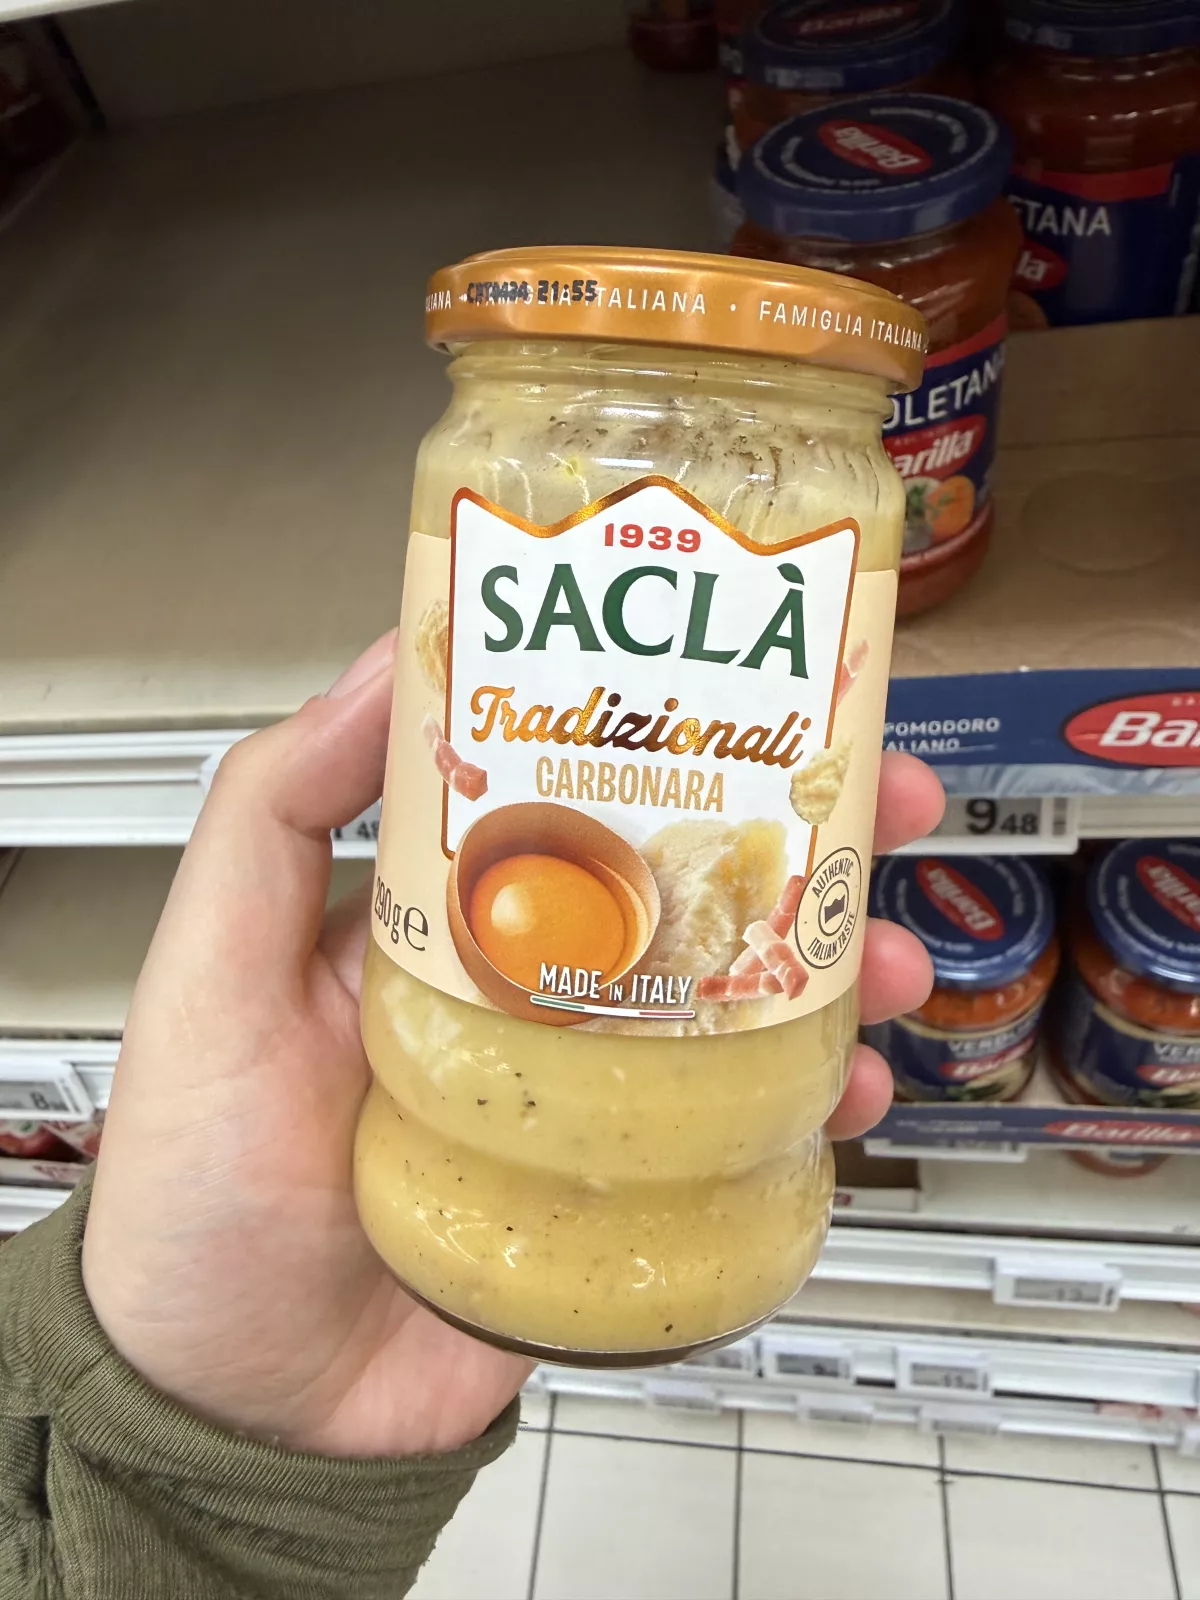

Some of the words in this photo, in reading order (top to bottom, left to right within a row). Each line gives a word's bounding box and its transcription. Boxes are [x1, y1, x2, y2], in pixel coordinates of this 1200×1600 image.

[538, 279, 599, 303] 21:55
[583, 287, 706, 315] TALIANA
[759, 300, 863, 337] FAMIGLIA
[870, 318, 923, 352] ITALIANA
[889, 429, 975, 476] arilla
[604, 523, 702, 554] 1939
[480, 563, 810, 680] SACLÀ
[470, 685, 812, 770] Tradizionali
[884, 737, 961, 753] ALIANO
[885, 717, 1001, 737] POMODORO
[535, 755, 726, 813] CARBONARA
[965, 797, 998, 836] 9
[1000, 812, 1039, 836] 48
[811, 857, 854, 899] AUTHENTIC
[807, 936, 838, 961] ITALIAN
[837, 911, 855, 949] TASTE
[538, 962, 602, 999] MADE
[608, 981, 624, 1001] IN
[630, 973, 694, 1006] ITALY
